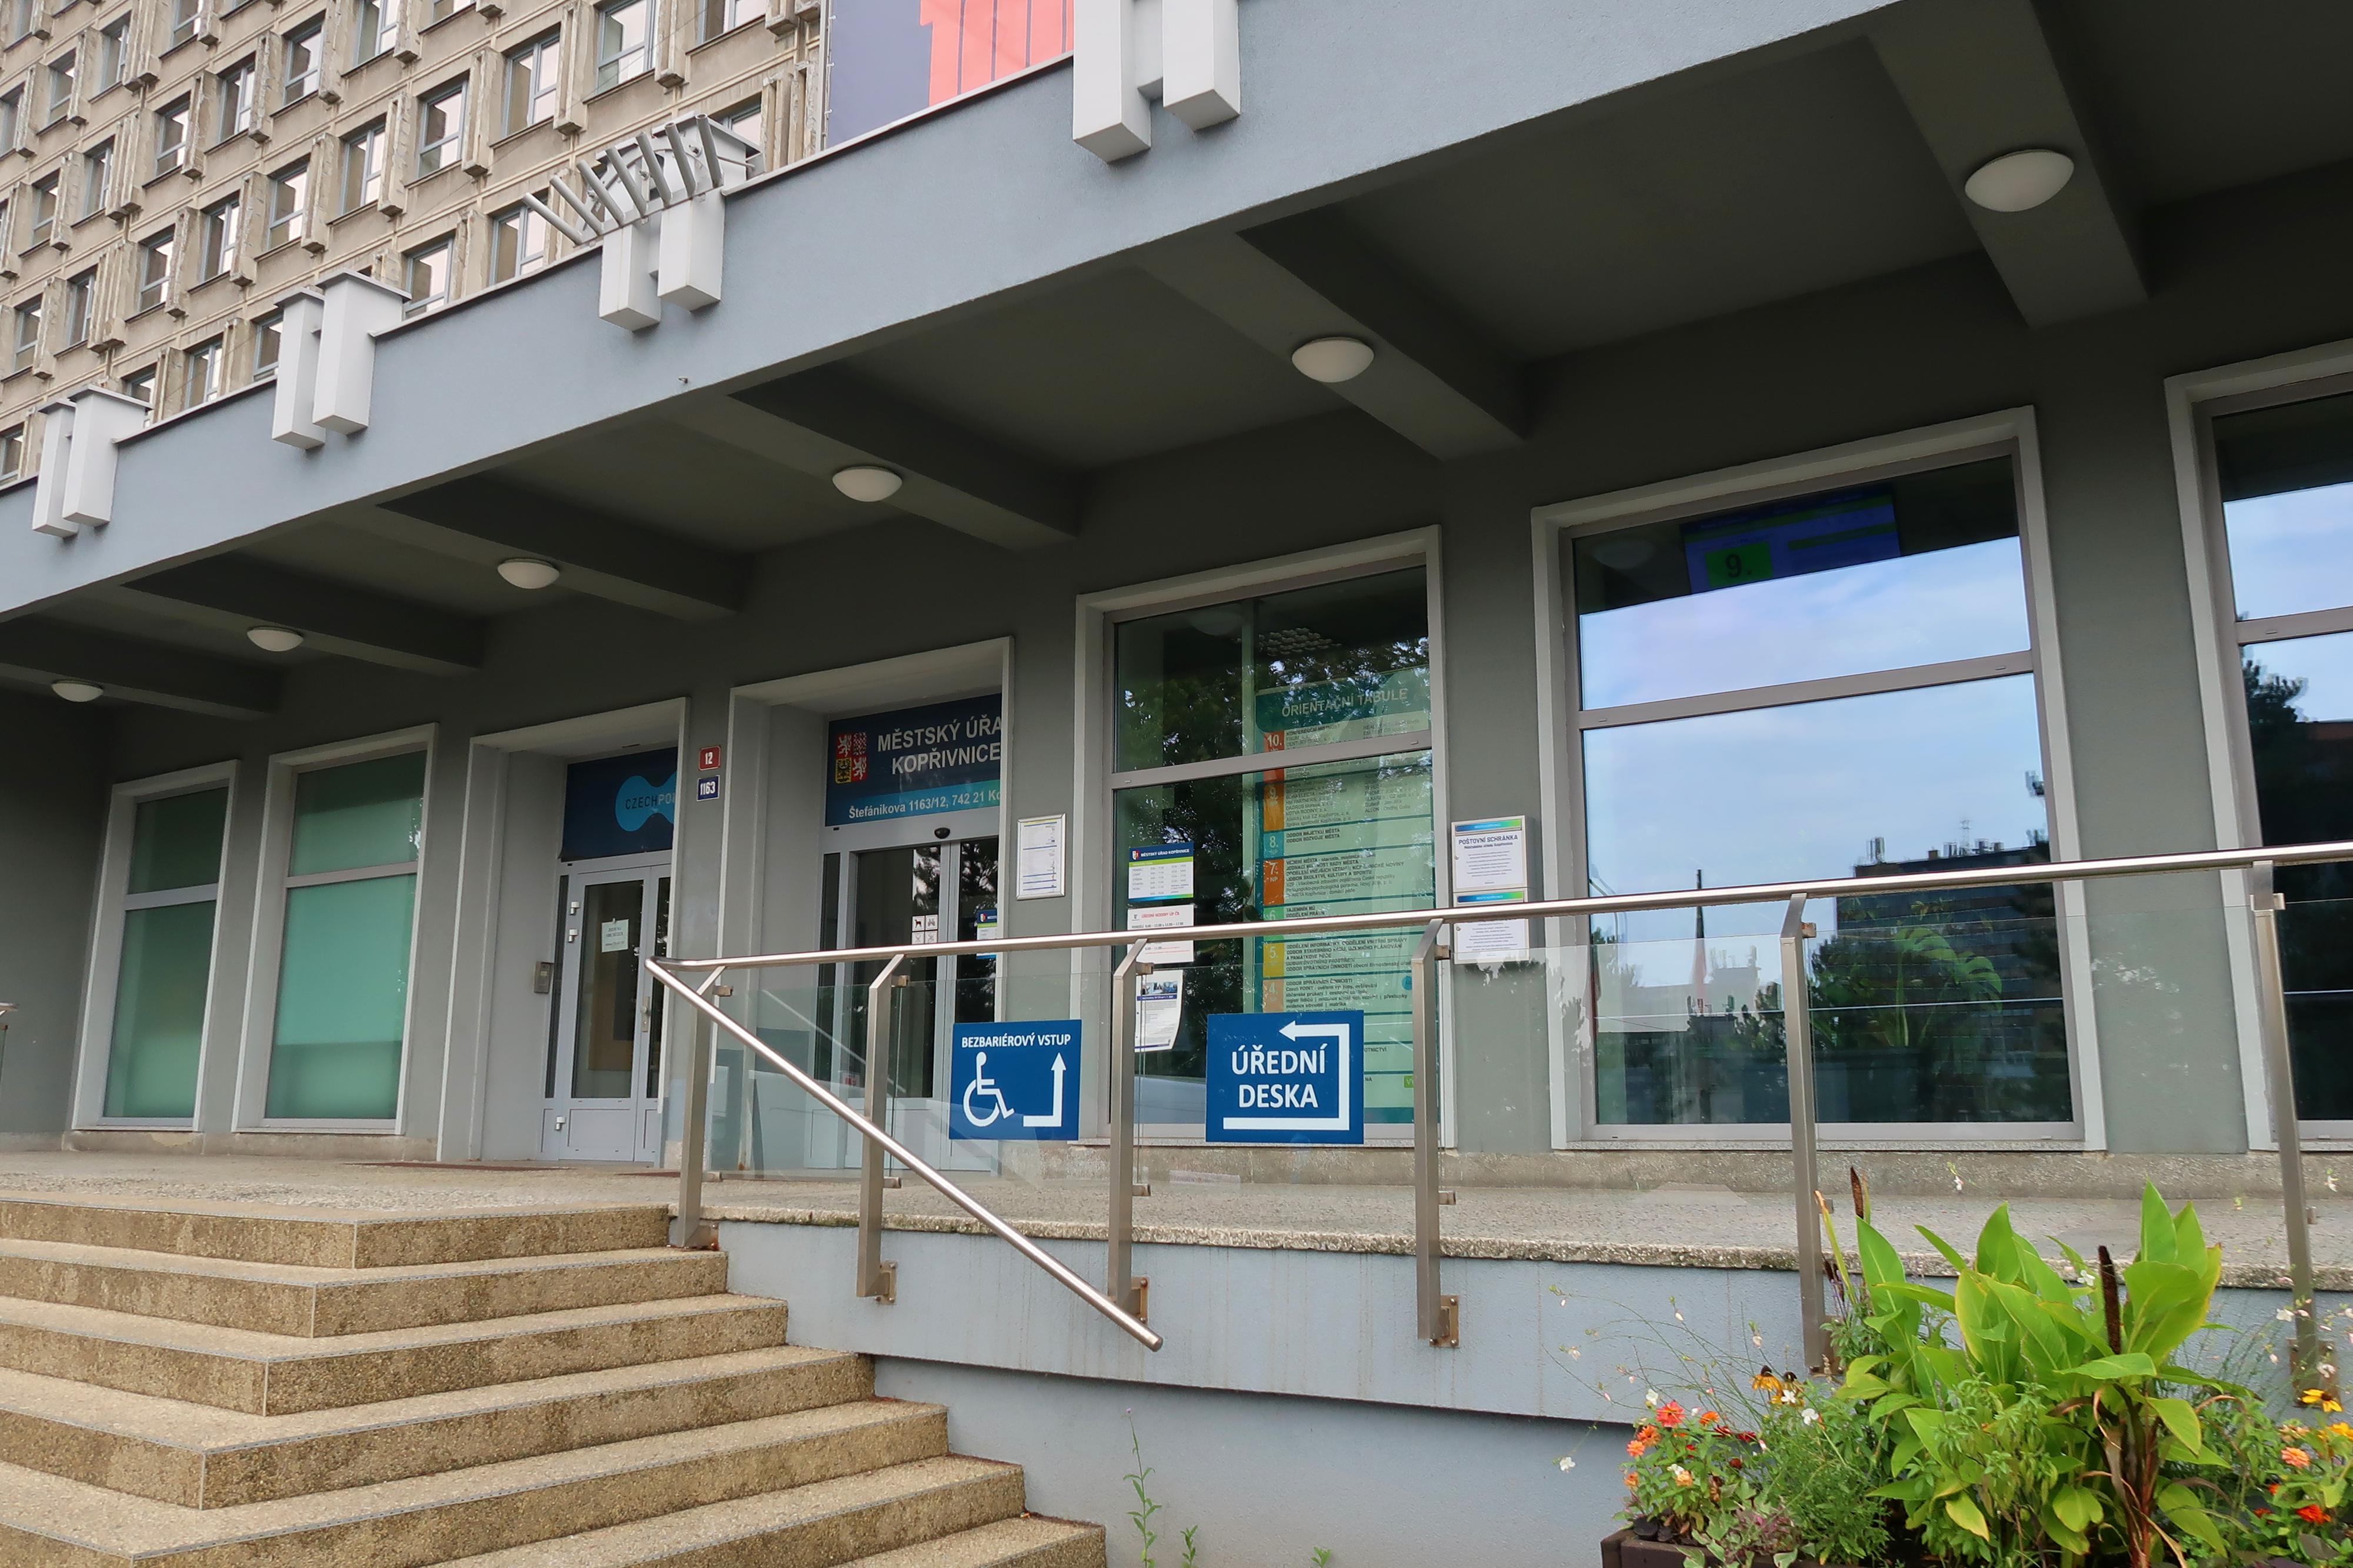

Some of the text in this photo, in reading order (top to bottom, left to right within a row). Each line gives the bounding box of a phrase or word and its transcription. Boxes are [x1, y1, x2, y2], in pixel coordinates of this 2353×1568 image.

[1725, 553, 1752, 578] 9.
[1282, 689, 1408, 718] ORIENTAČNÍ TABULE
[878, 714, 1001, 752] MĚSTSKÝ ÚŘA
[1267, 734, 1282, 747] 10.
[705, 752, 714, 765] 12
[892, 742, 1001, 775] KOPŘIVNICE
[699, 781, 715, 796] 1163
[625, 793, 676, 810] CZECHPOI
[849, 789, 1001, 819] Štefánikova 1163/12, 742 21 Ko
[1269, 835, 1278, 848] 8.
[1487, 835, 1518, 843] SCHRÁNKA
[1269, 946, 1278, 959] 5.
[962, 1032, 1071, 1048] BEZBARIÉROVÝ VSTUP
[1232, 1043, 1328, 1075] ÚŘEDNÍ
[1239, 1084, 1318, 1109] DESKA
